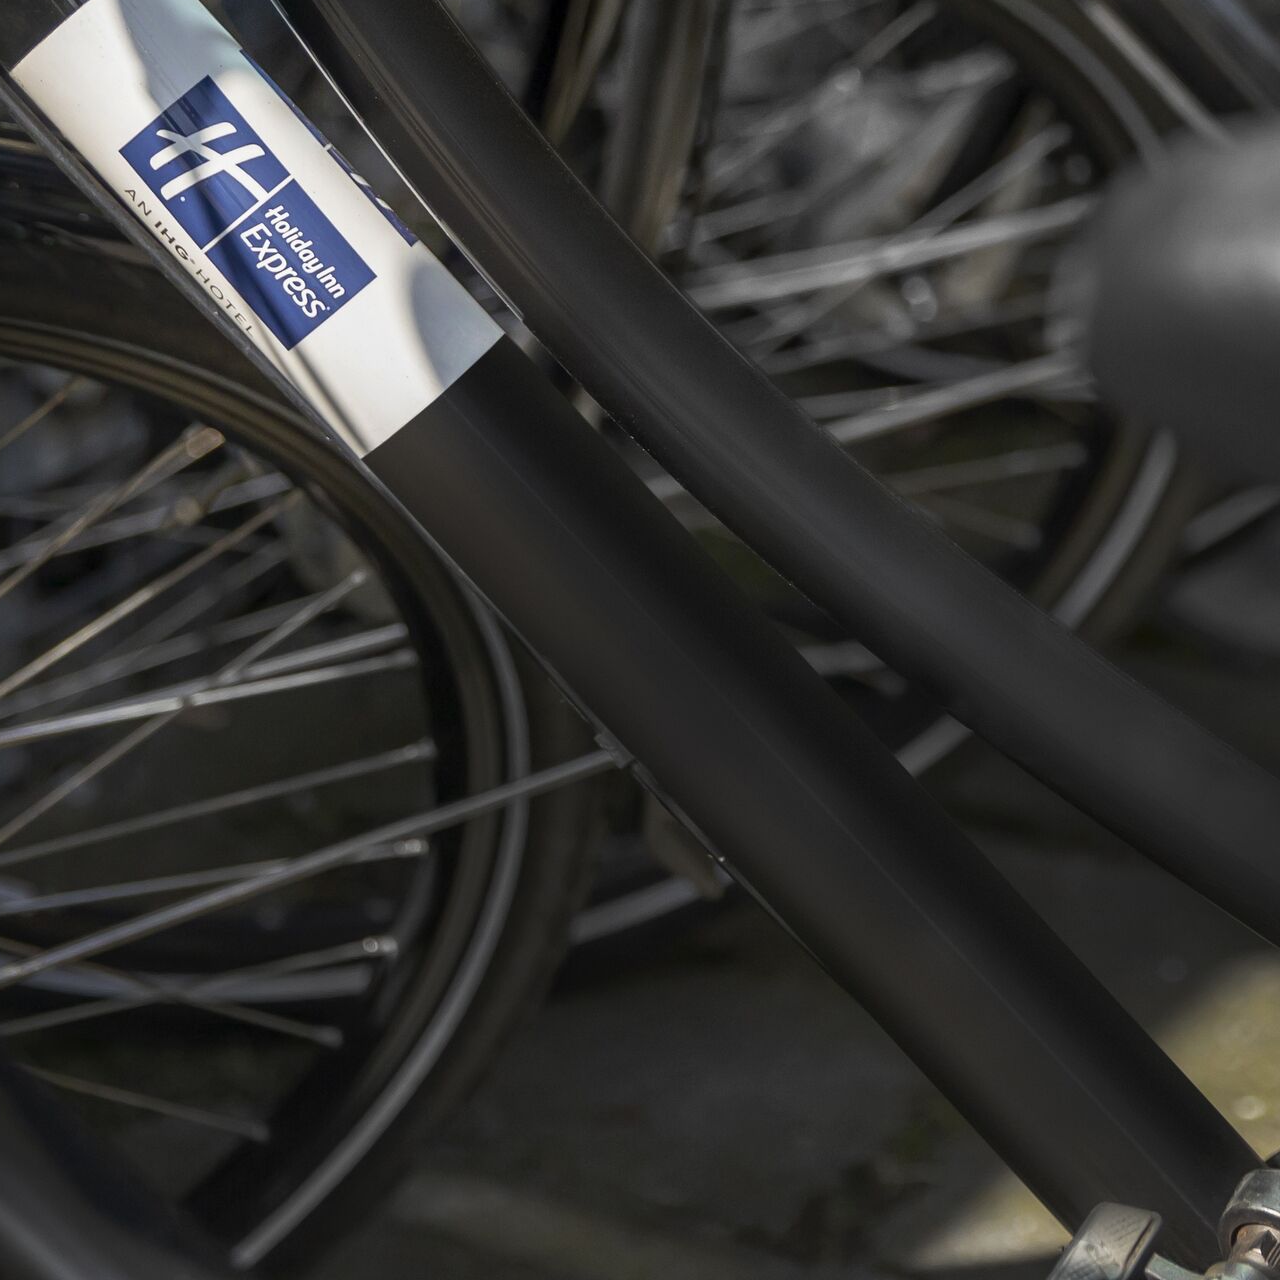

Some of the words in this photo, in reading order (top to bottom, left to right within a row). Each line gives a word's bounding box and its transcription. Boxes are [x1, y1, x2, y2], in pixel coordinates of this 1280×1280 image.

[124, 187, 153, 217] AN
[154, 220, 190, 262] IHG
[196, 268, 256, 339] HOTEL
[239, 222, 327, 318] Express
[264, 204, 324, 274] Holiday
[315, 265, 346, 300] Inn
